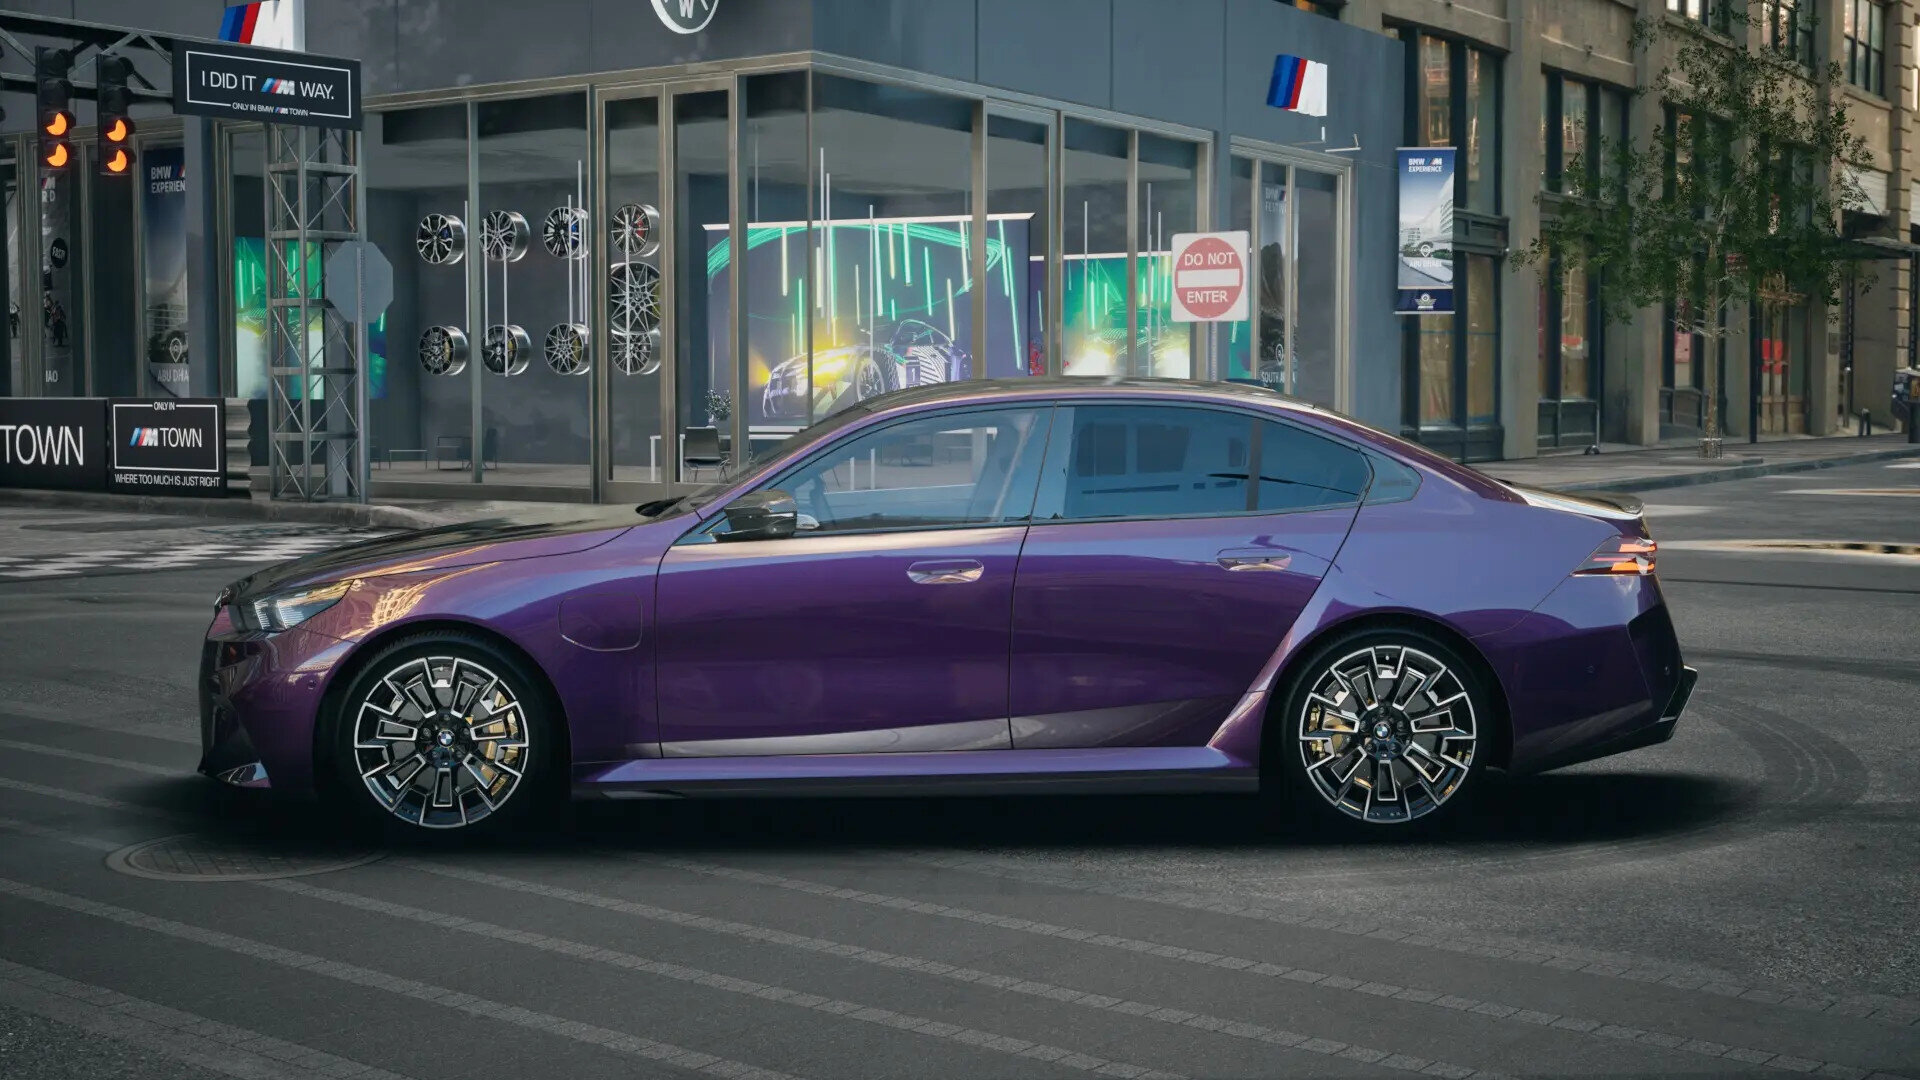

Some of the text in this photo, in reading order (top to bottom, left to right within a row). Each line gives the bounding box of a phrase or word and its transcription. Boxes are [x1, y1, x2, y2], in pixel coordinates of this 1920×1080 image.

[201, 70, 206, 87] I
[210, 71, 238, 90] DID
[242, 75, 257, 92] IT
[299, 81, 335, 100] WAY.
[232, 102, 249, 111] ONLY
[257, 105, 275, 113] BMW
[289, 107, 309, 117] TOWN
[1408, 157, 1425, 166] BMW
[150, 166, 172, 180] BMW
[1408, 165, 1443, 173] EXPERIENCE
[151, 180, 186, 194] EXPERIEN
[1184, 251, 1235, 266] DO NOT
[1186, 290, 1229, 304] ENTER
[158, 369, 171, 383] ABU
[153, 401, 176, 411] ONLY IN
[159, 427, 203, 448] TOWN
[0, 424, 84, 466] TOWN
[114, 473, 221, 488] WHERE TOO MUCH IS JUST RIGHT
